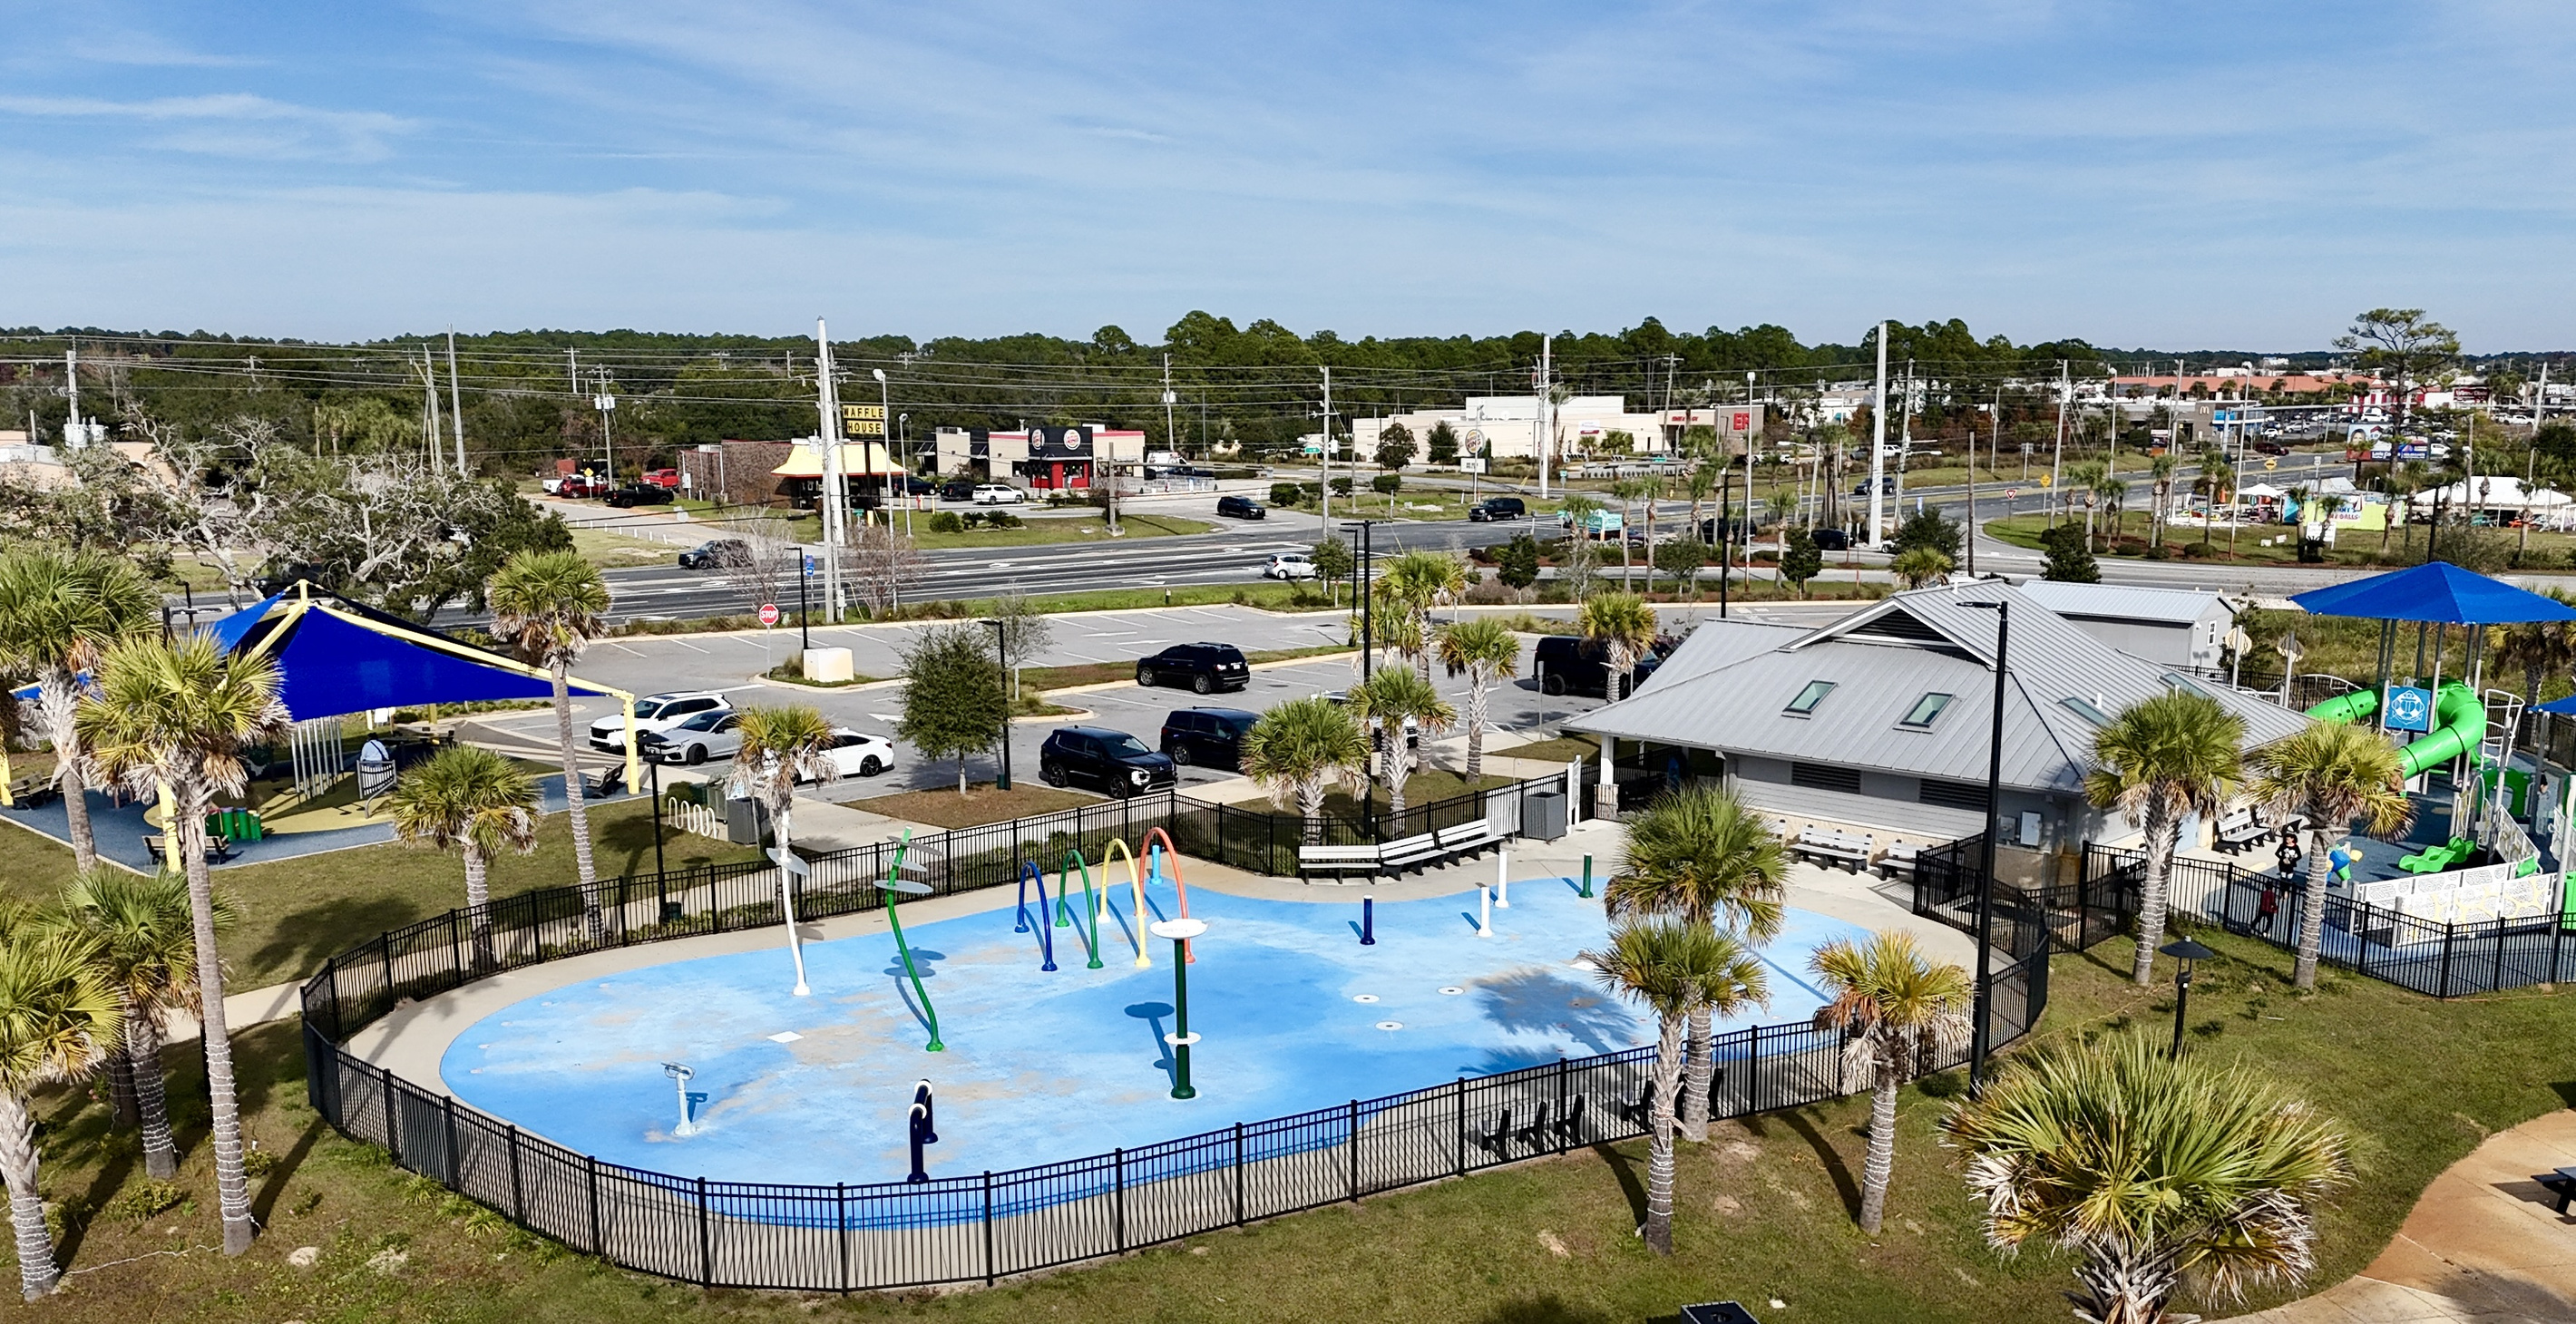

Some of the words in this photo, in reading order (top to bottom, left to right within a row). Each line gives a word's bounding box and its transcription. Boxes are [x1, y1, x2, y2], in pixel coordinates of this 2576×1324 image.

[844, 407, 884, 418] WAFFLE
[847, 422, 882, 433] HOUSE
[761, 609, 776, 618] STOP
